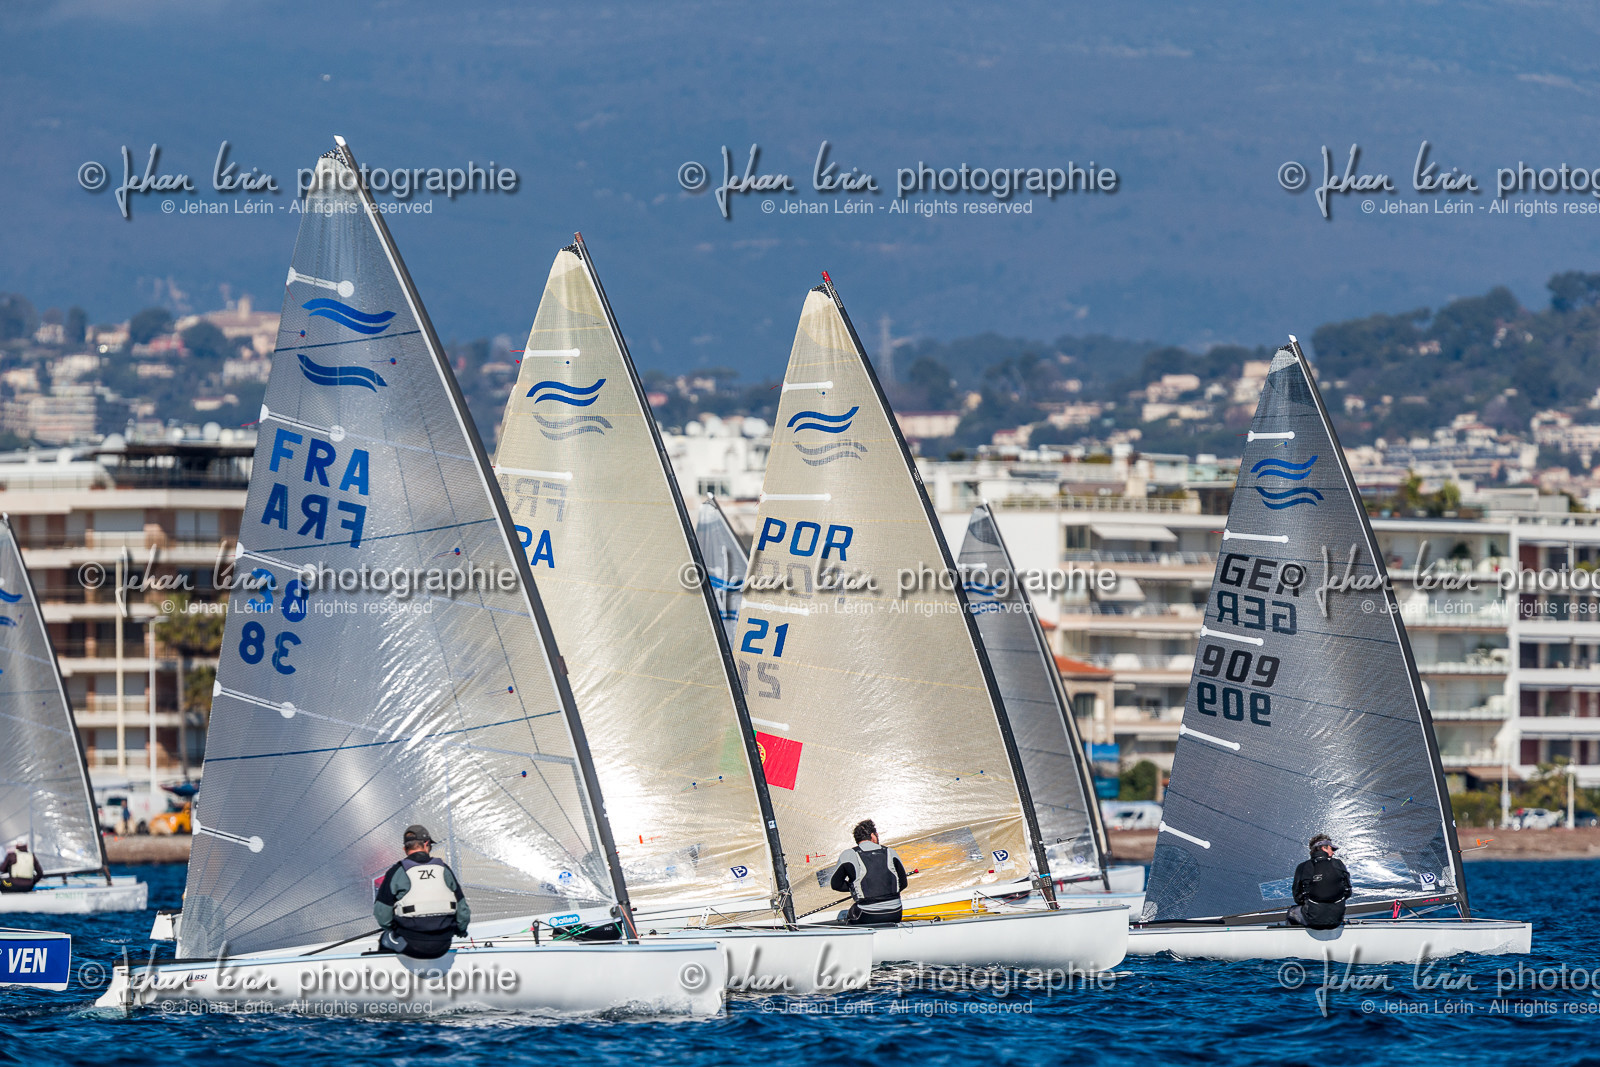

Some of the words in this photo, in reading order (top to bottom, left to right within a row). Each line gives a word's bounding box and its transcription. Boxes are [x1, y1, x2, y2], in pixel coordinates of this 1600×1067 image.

[269, 428, 369, 496] FRA
[757, 516, 854, 562] POR
[247, 568, 310, 623] 38
[1219, 553, 1306, 597] GER
[740, 617, 789, 658] 21
[1199, 644, 1281, 688] 909
[417, 869, 436, 880] ZK
[8, 947, 48, 974] VEN
